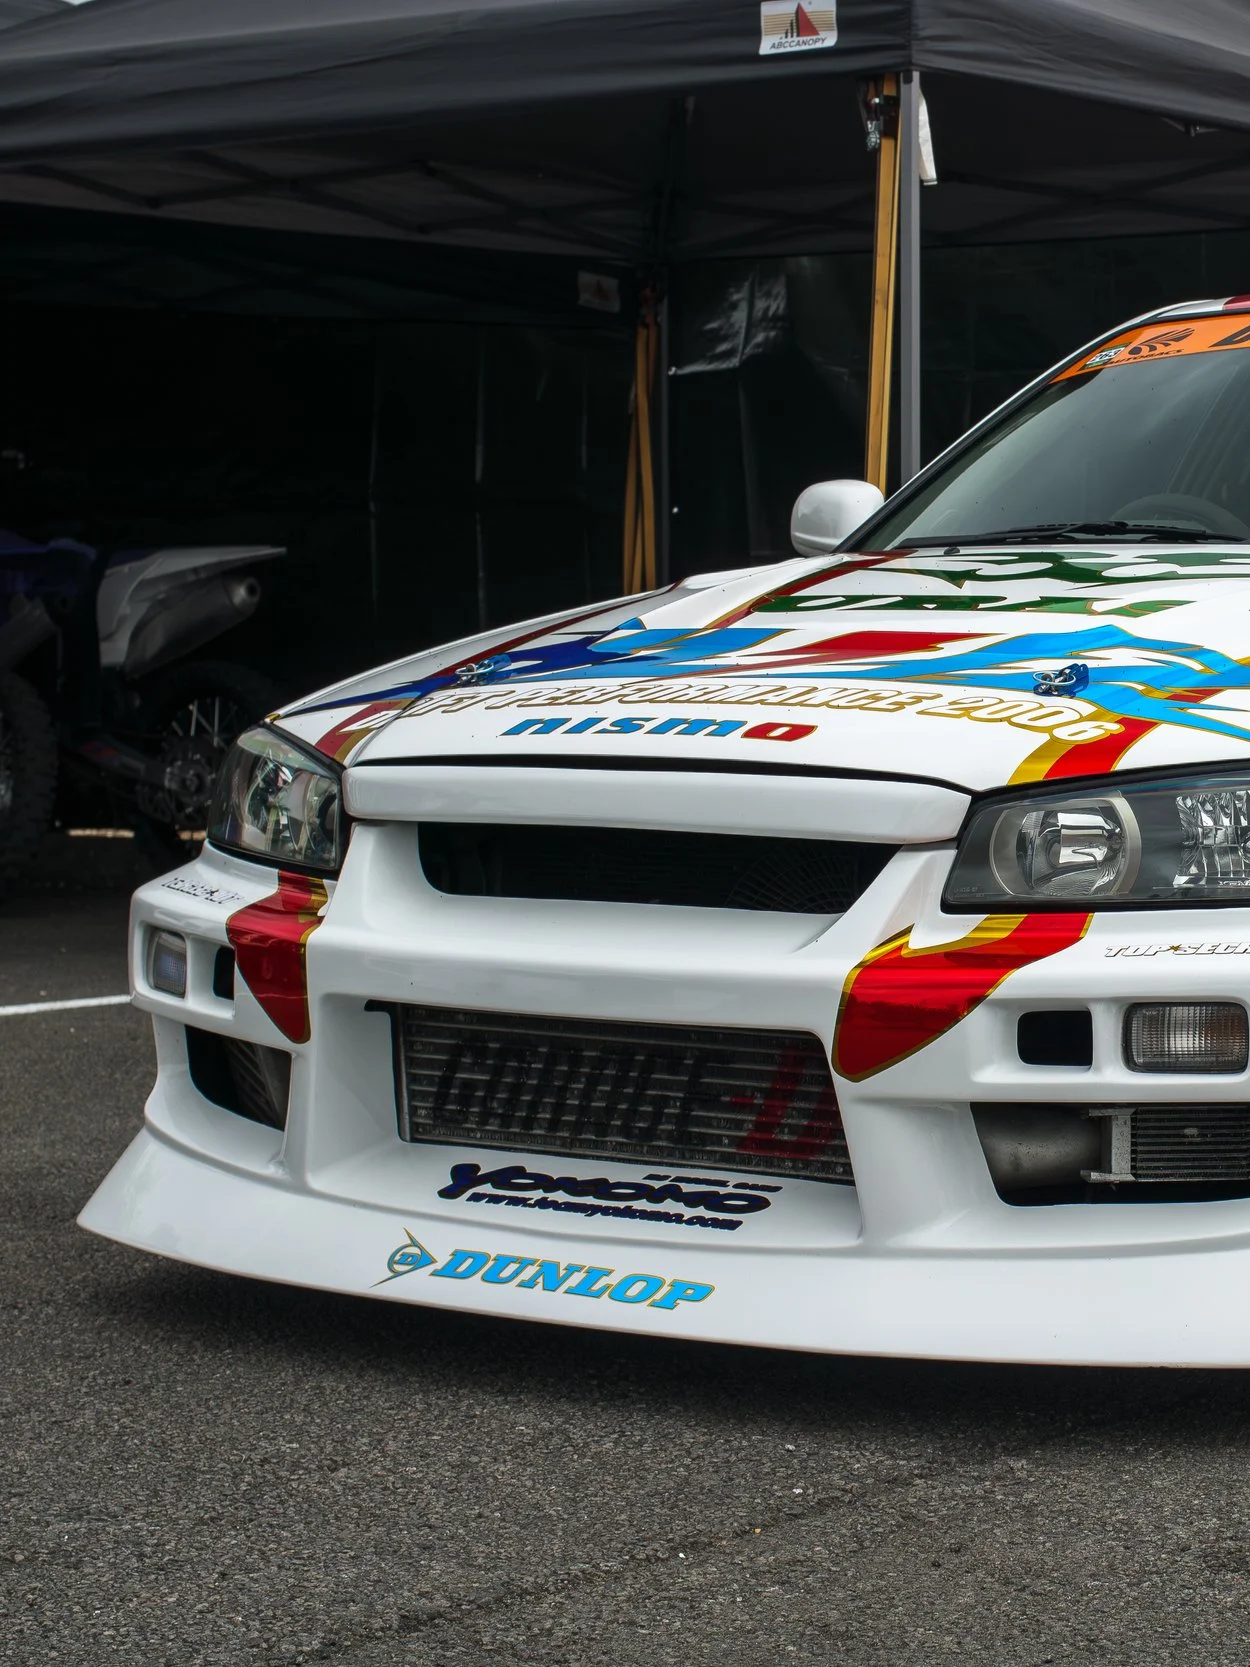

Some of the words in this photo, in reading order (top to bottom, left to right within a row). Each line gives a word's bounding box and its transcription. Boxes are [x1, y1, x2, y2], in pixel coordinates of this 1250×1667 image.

[769, 37, 827, 50] ABCCANOPY
[485, 683, 943, 712] PERFORMANCE
[916, 696, 1125, 745] 2006
[500, 716, 818, 742] nismo
[1104, 944, 1171, 958] TOP
[437, 1163, 772, 1214] YOKOMO
[431, 1248, 715, 1311] DUNLOP
